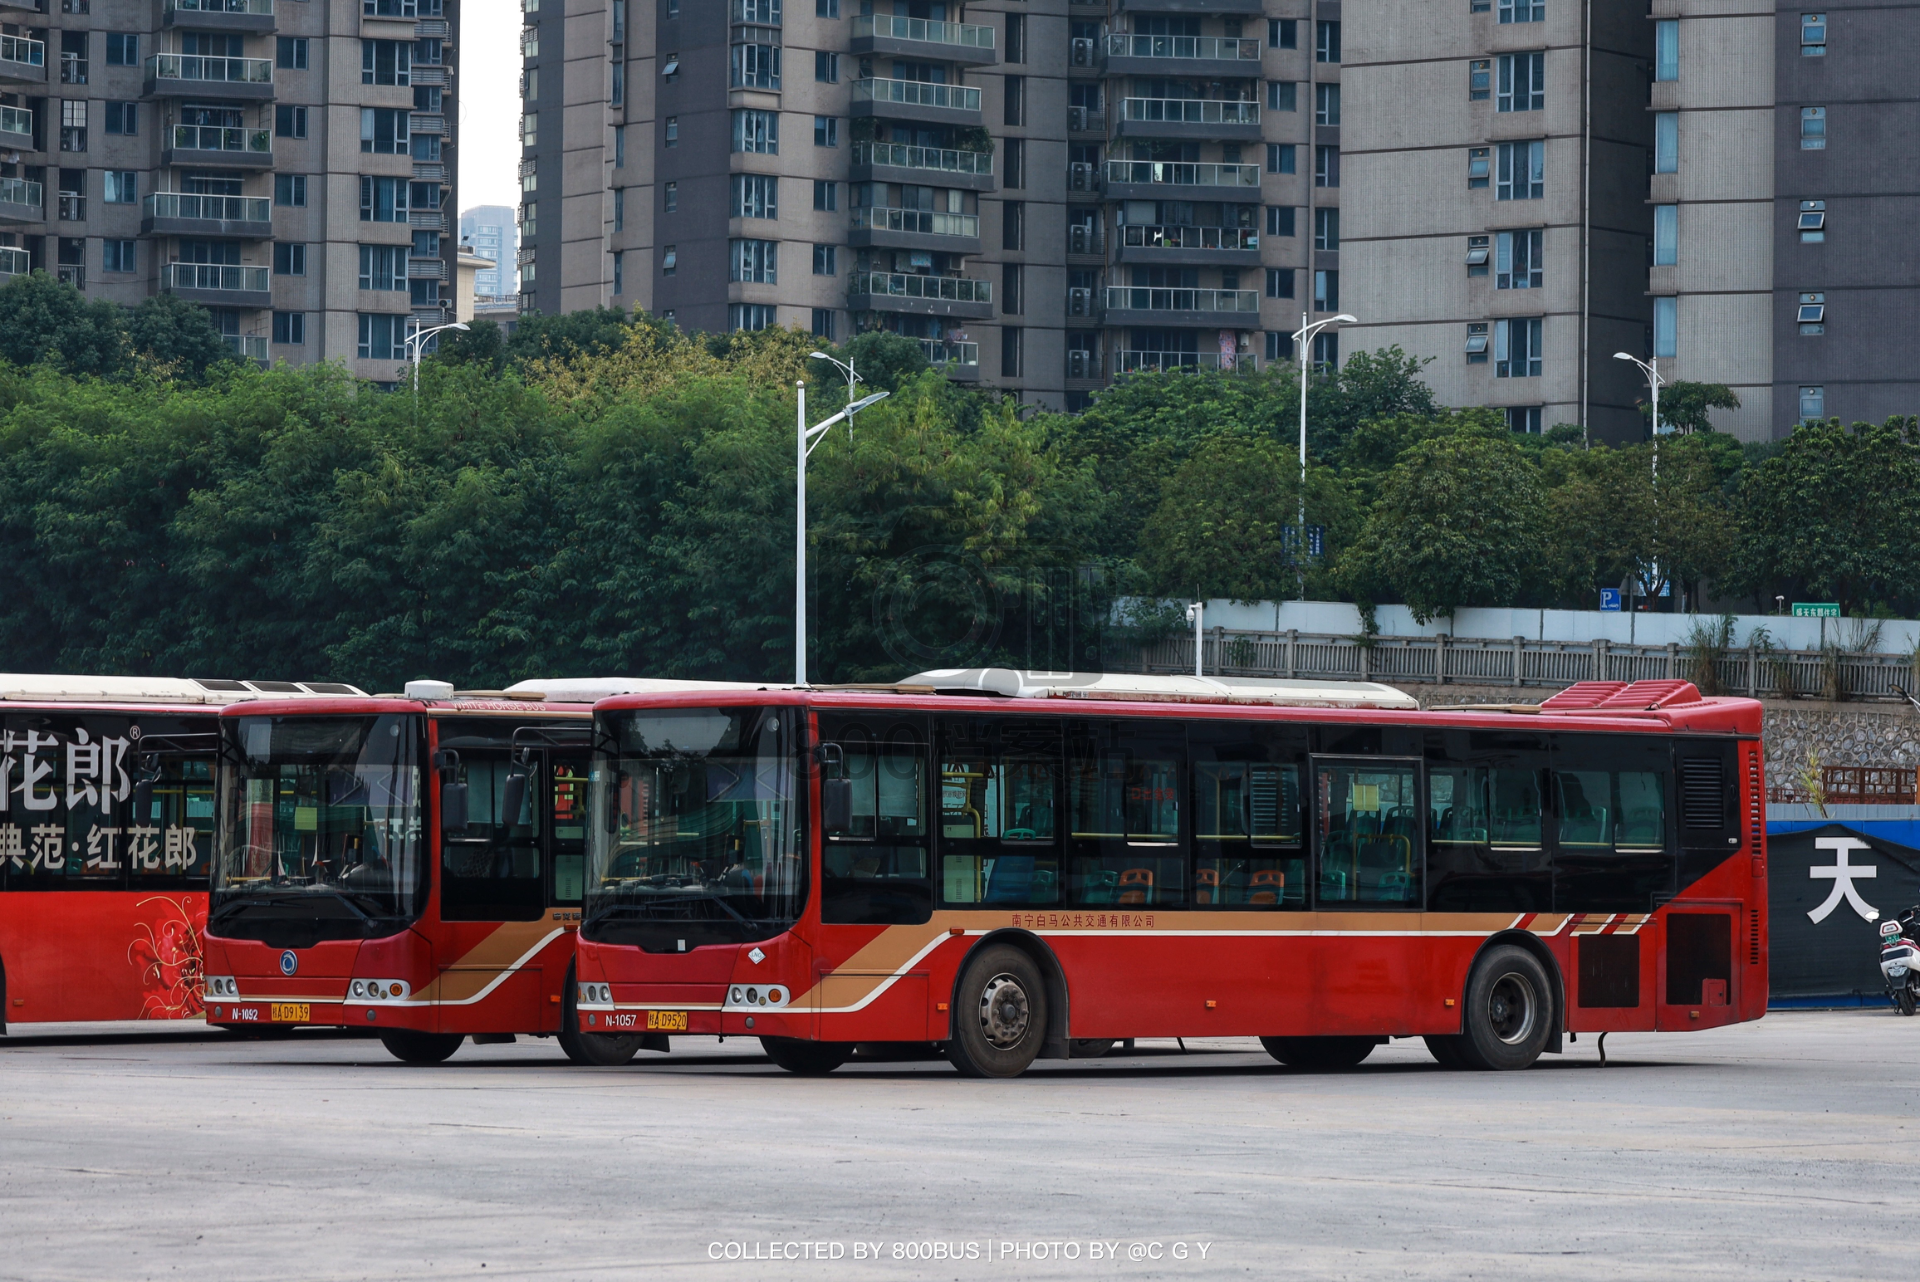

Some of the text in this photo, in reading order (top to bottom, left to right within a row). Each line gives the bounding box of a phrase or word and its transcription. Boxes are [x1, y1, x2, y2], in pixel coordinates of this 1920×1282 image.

[1601, 591, 1612, 608] P
[452, 701, 546, 711] WHITE HORSE BUS
[1807, 837, 1879, 924] 天
[1012, 913, 1155, 928] 南宁白马公共交通有限公司
[605, 1014, 637, 1026] N-1057
